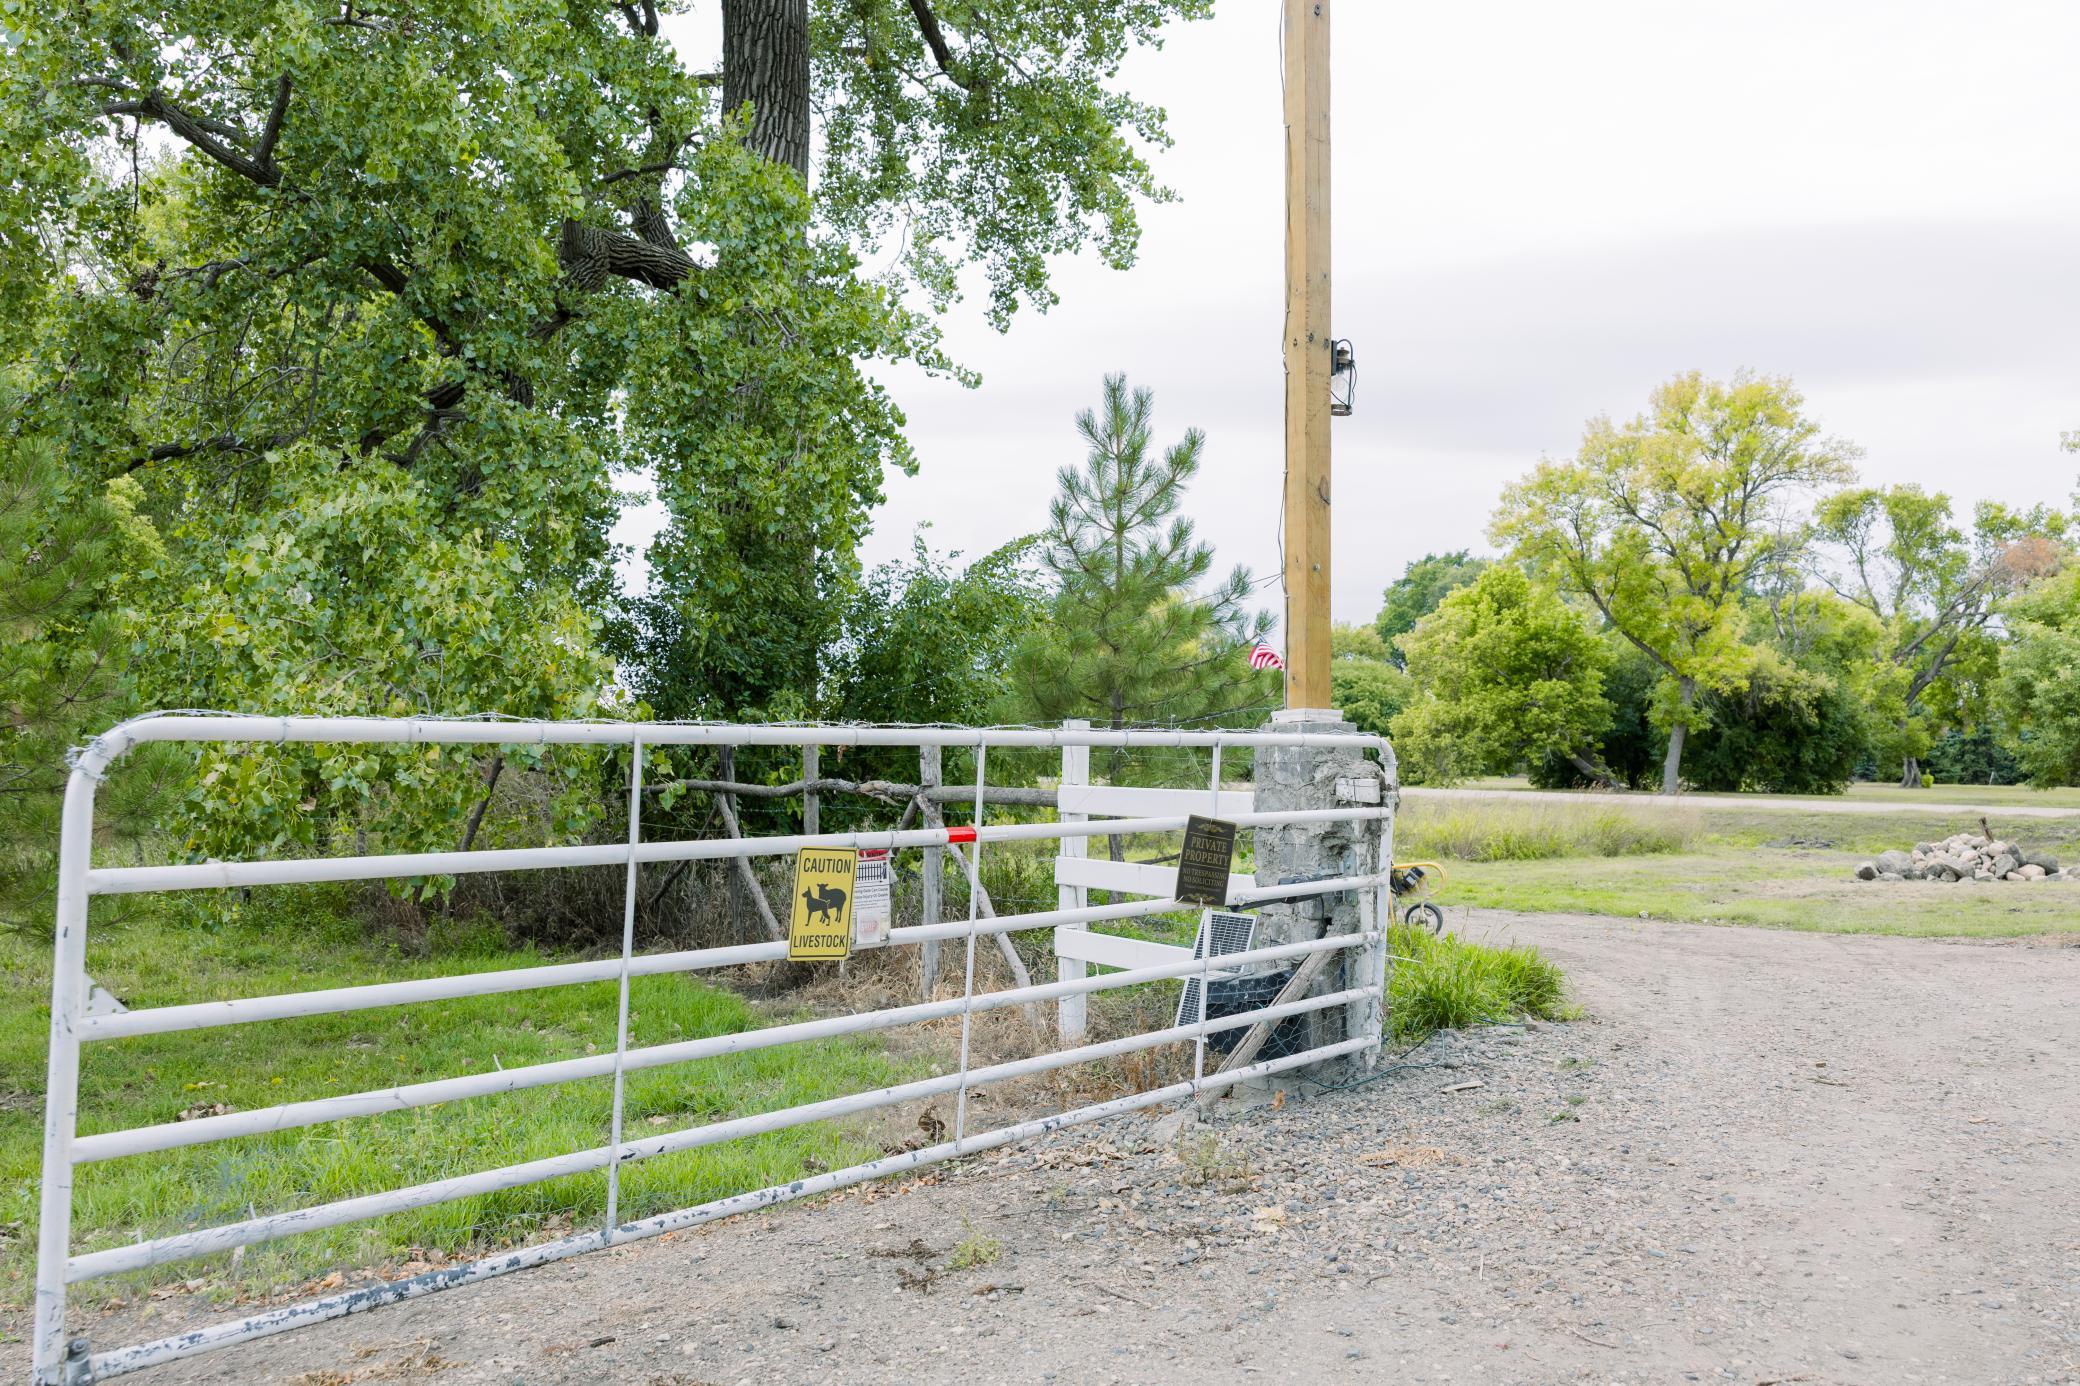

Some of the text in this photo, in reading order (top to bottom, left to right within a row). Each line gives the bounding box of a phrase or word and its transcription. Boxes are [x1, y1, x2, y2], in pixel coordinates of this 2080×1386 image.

[1191, 836, 1228, 853] PRIVATE
[1184, 849, 1230, 866] PROPERTY
[803, 857, 851, 874] CAUTION
[1191, 868, 1227, 880] TRESPASSING
[1192, 876, 1225, 887] SOLICITING
[793, 934, 846, 948] LIVESTOCK
